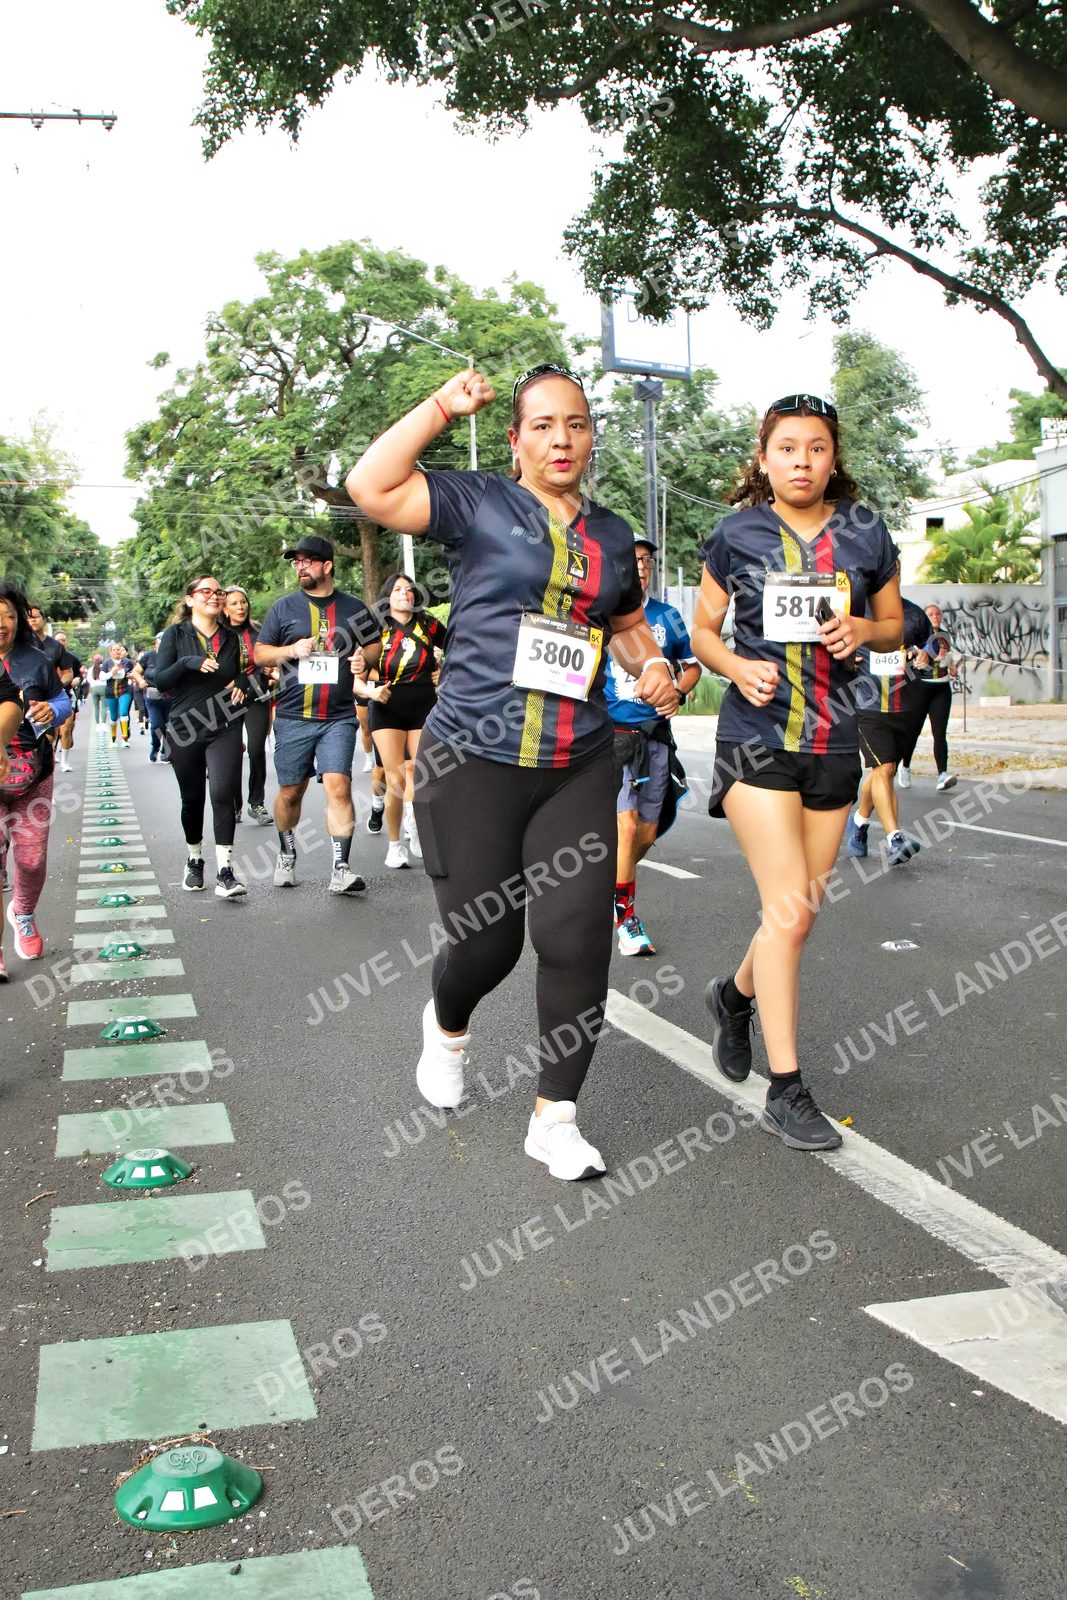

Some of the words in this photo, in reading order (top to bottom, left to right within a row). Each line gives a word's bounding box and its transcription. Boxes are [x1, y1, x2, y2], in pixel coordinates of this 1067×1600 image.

[774, 595, 831, 618] 581
[528, 638, 585, 672] 5800
[875, 654, 900, 666] 6465
[309, 660, 328, 672] 751
